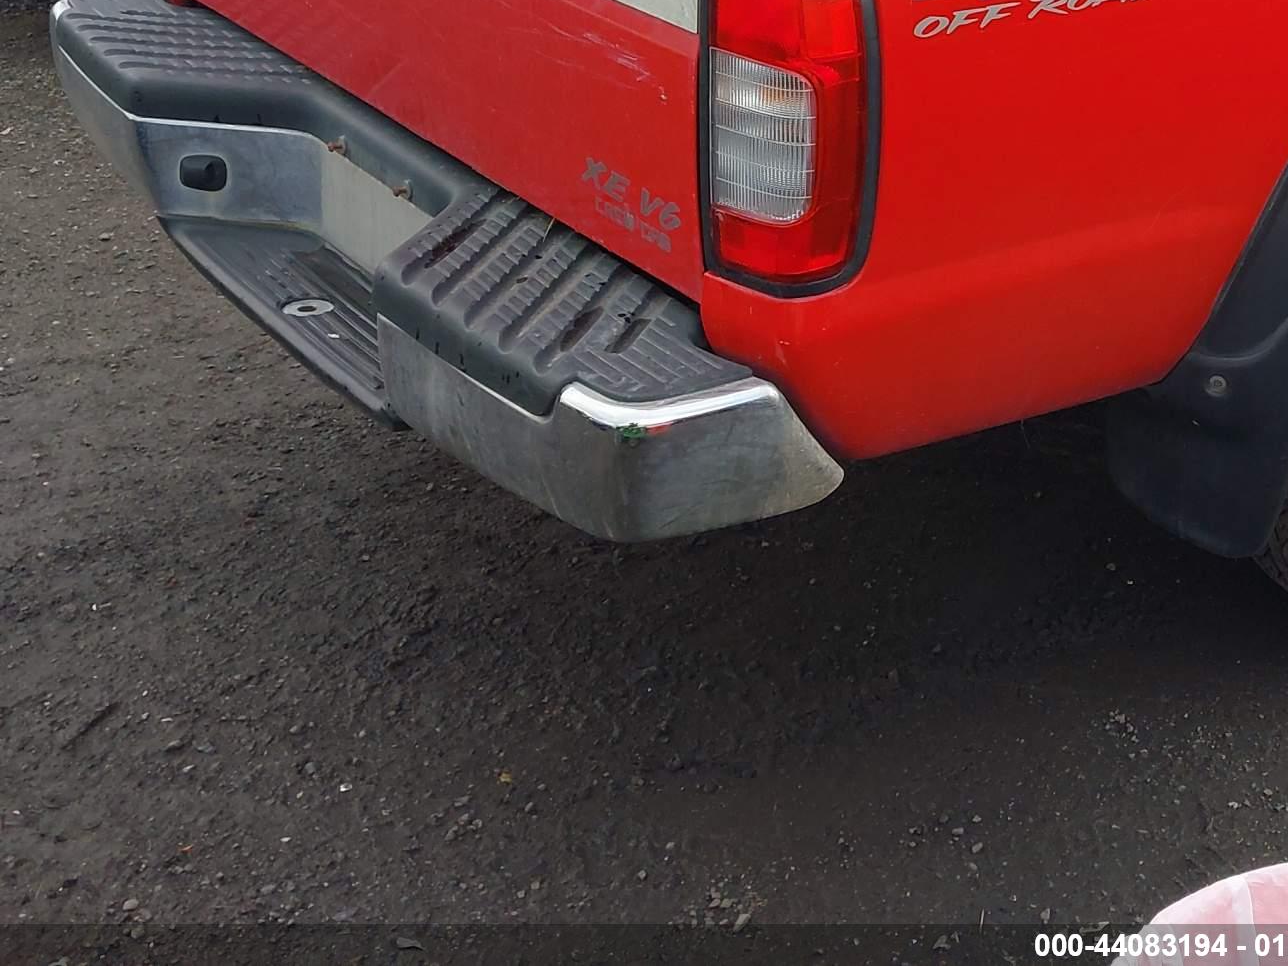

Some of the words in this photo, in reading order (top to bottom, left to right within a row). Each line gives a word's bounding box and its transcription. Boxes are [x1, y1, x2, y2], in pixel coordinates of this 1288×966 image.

[913, 1, 1022, 39] OFF
[581, 156, 631, 203] XE
[640, 186, 681, 231] V6
